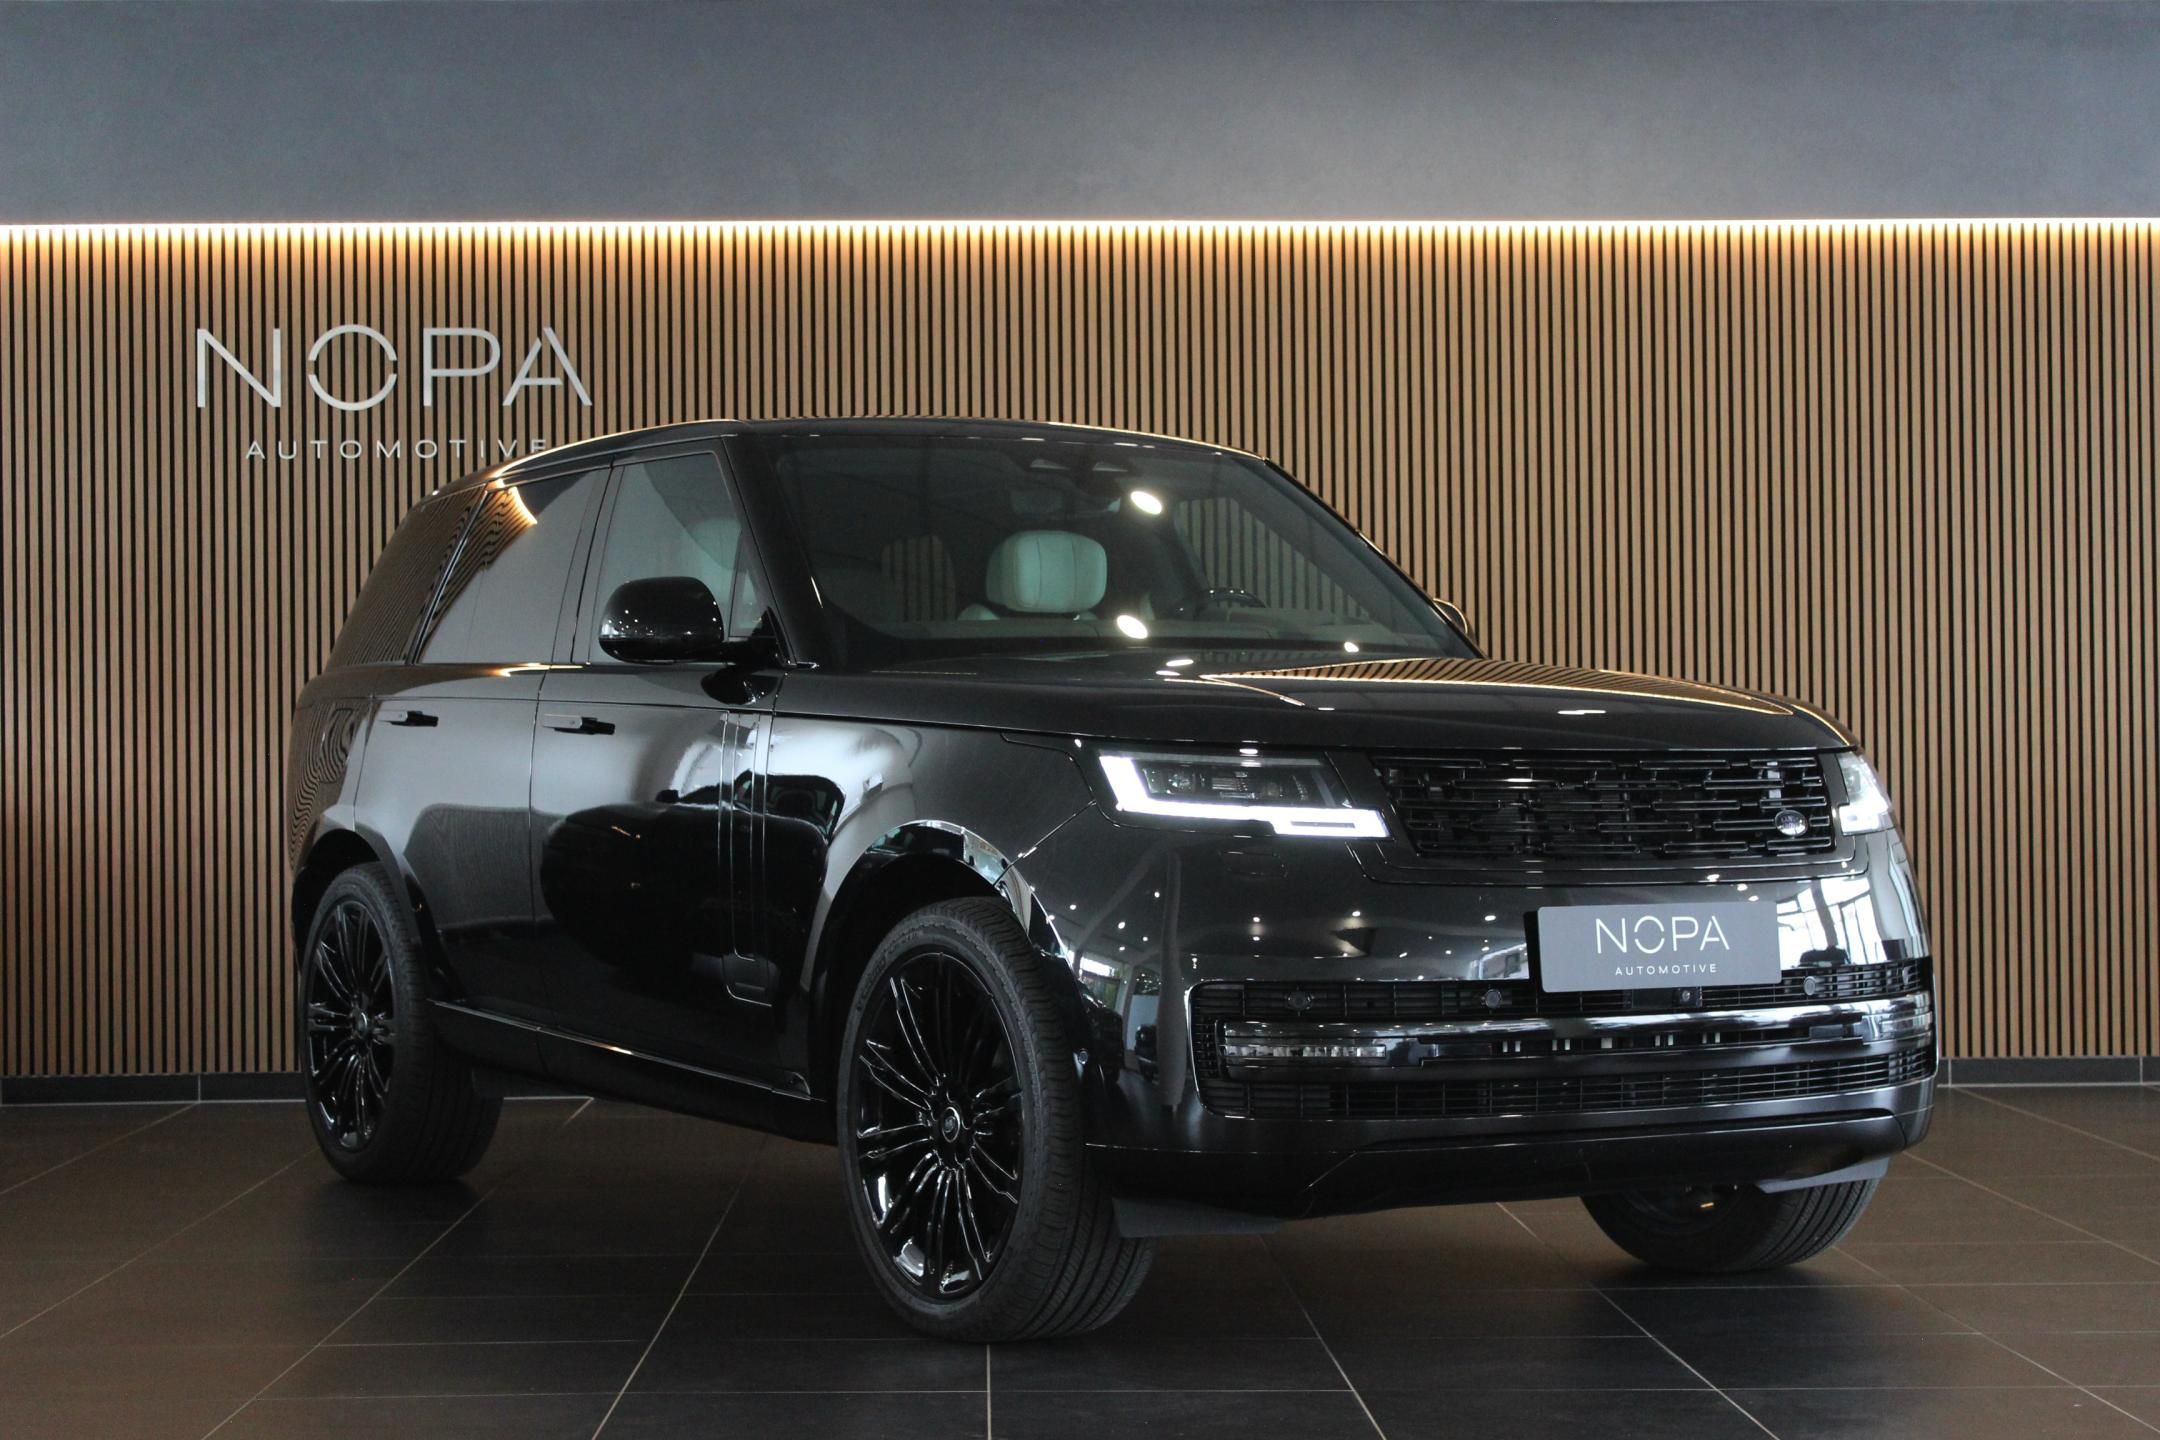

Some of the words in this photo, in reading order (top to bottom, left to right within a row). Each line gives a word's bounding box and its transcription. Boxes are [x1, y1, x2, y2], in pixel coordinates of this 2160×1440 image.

[197, 324, 593, 411] NOPA
[1596, 915, 1730, 954] NOPA
[1615, 963, 1717, 976] AUTOMOTIVE
